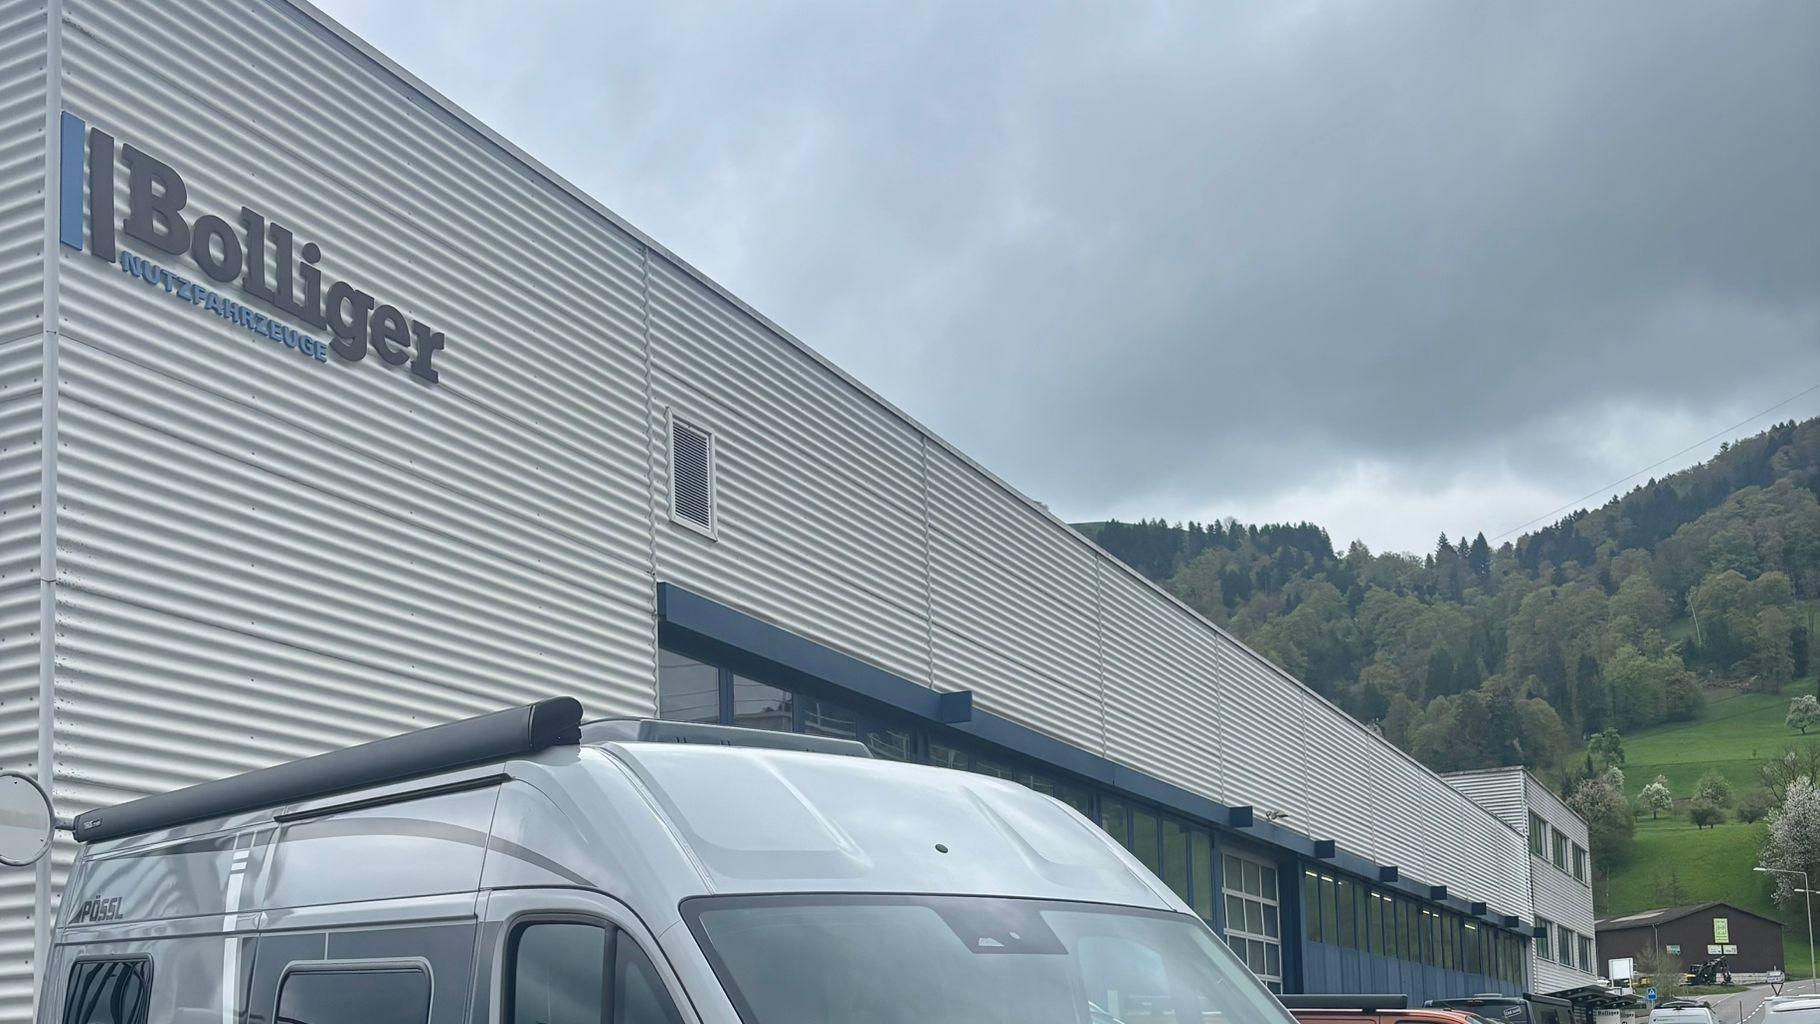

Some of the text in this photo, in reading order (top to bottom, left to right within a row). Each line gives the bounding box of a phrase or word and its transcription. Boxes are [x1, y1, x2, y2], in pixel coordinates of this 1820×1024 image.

[120, 250, 328, 364] NUTZFAHRZEUGE
[122, 142, 445, 384] Bolliger
[81, 895, 123, 923] PÖSSL
